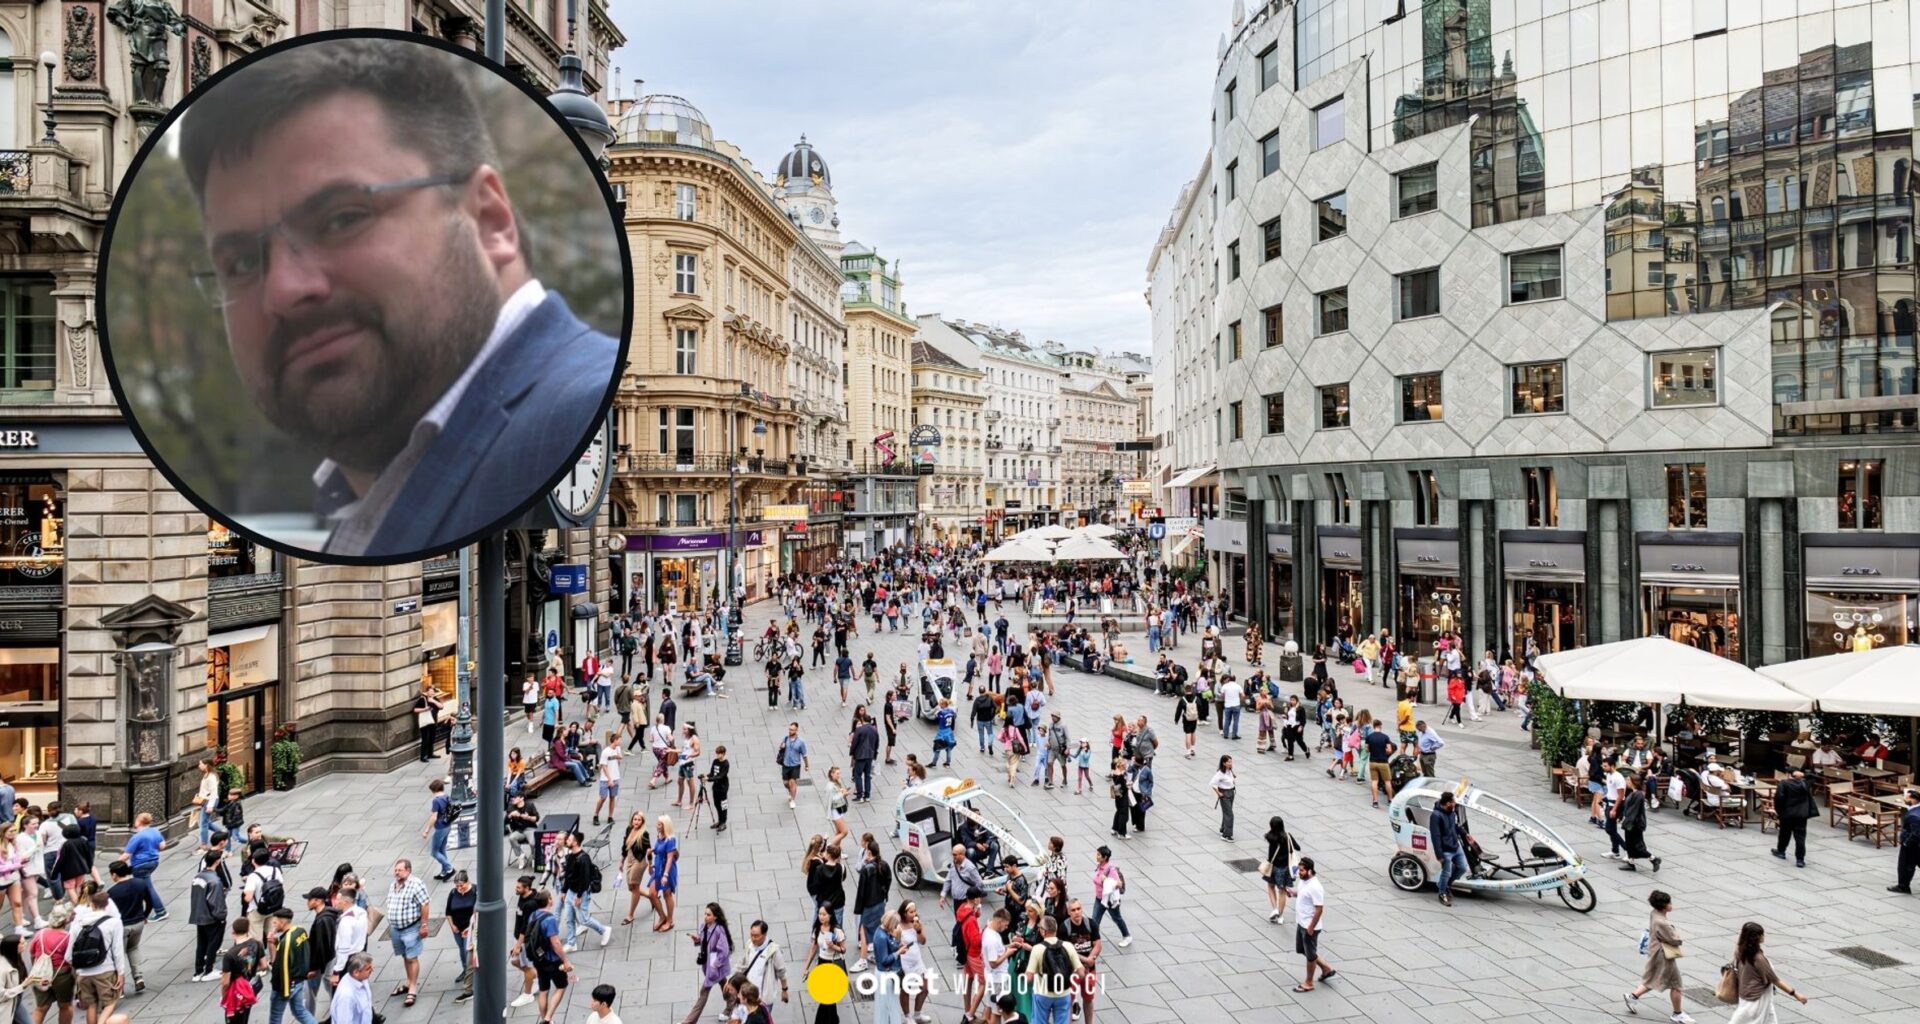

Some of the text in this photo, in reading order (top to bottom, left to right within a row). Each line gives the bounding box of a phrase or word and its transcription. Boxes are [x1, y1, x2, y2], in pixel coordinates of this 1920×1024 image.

[1152, 526, 1163, 538] U
[1671, 563, 1706, 572] ZARA
[1842, 566, 1882, 576] ZARA
